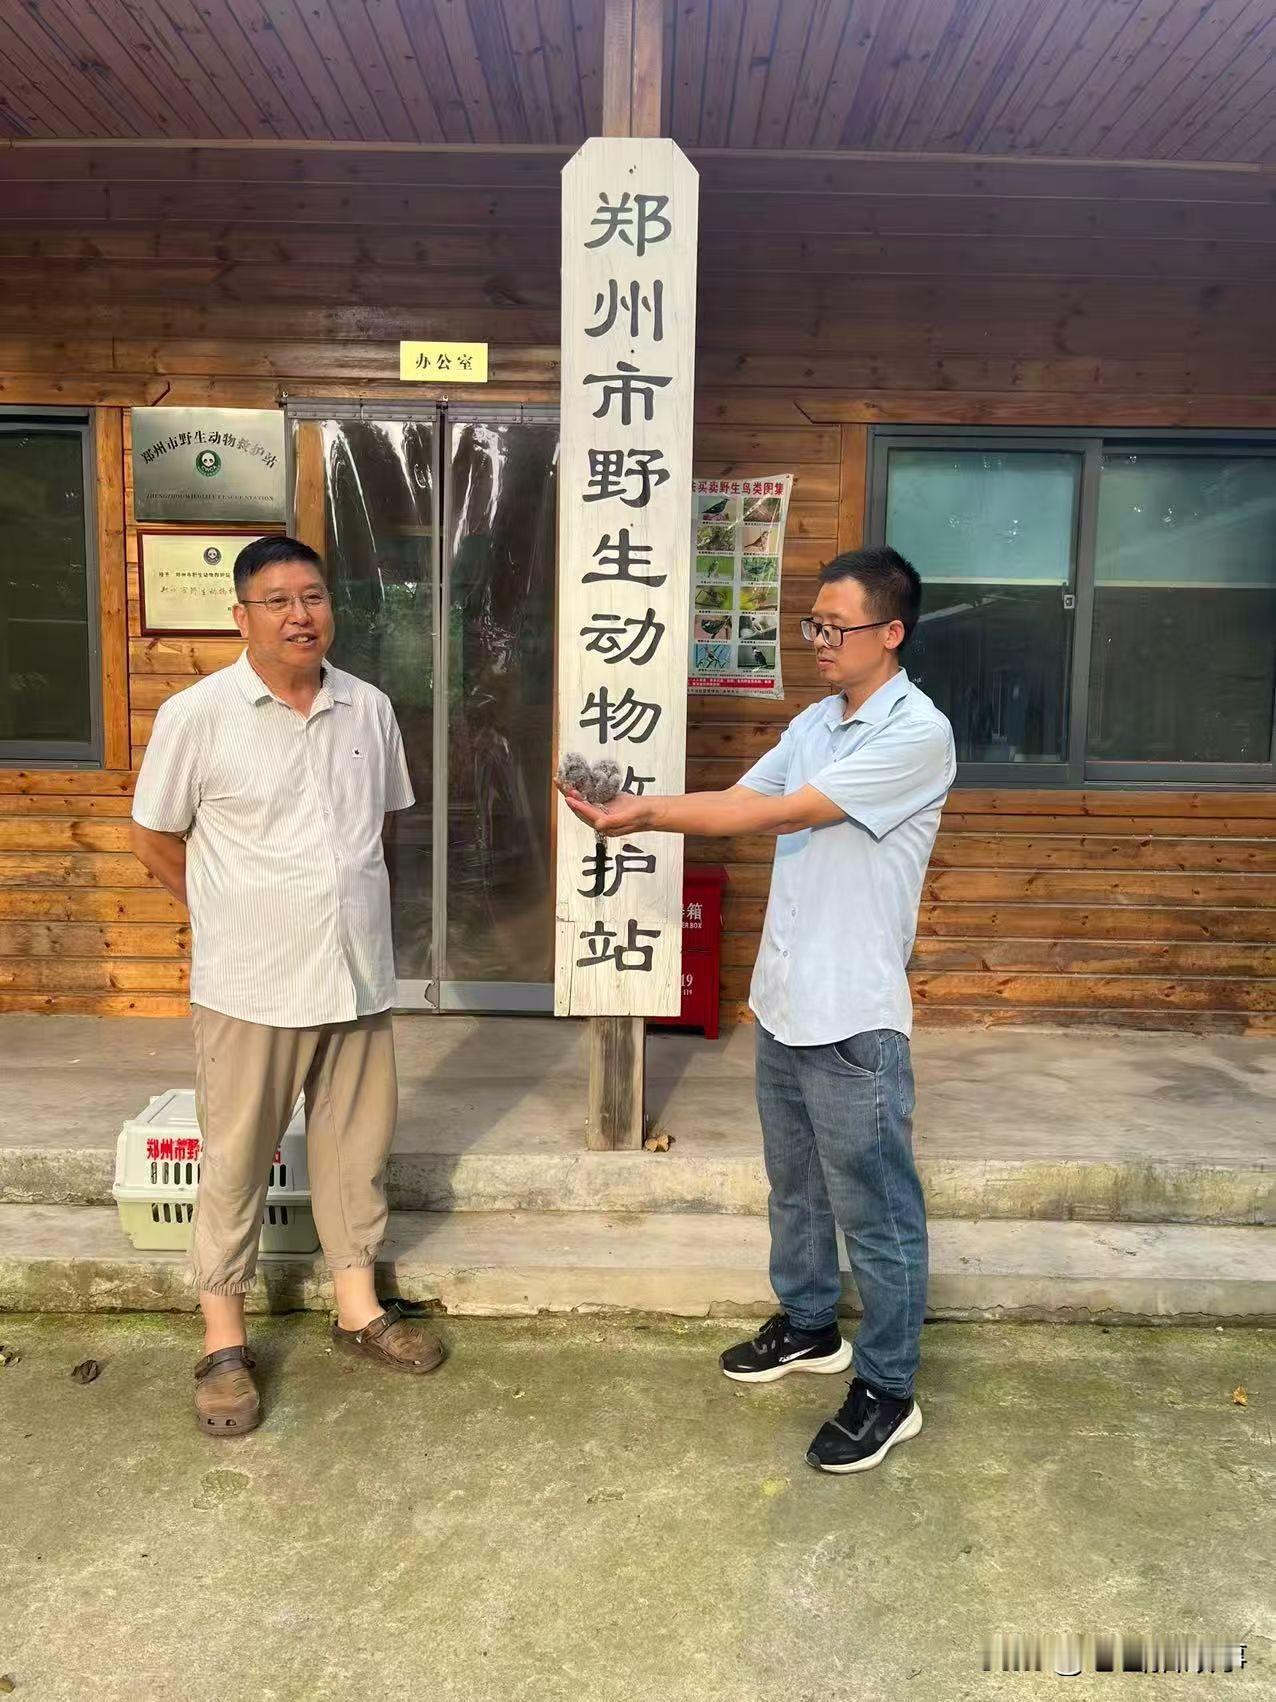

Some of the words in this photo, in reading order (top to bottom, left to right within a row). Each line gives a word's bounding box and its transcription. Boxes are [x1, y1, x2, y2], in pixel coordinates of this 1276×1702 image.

[416, 353, 473, 370] 办公室
[141, 430, 278, 468] 郑州市野生动物救护站
